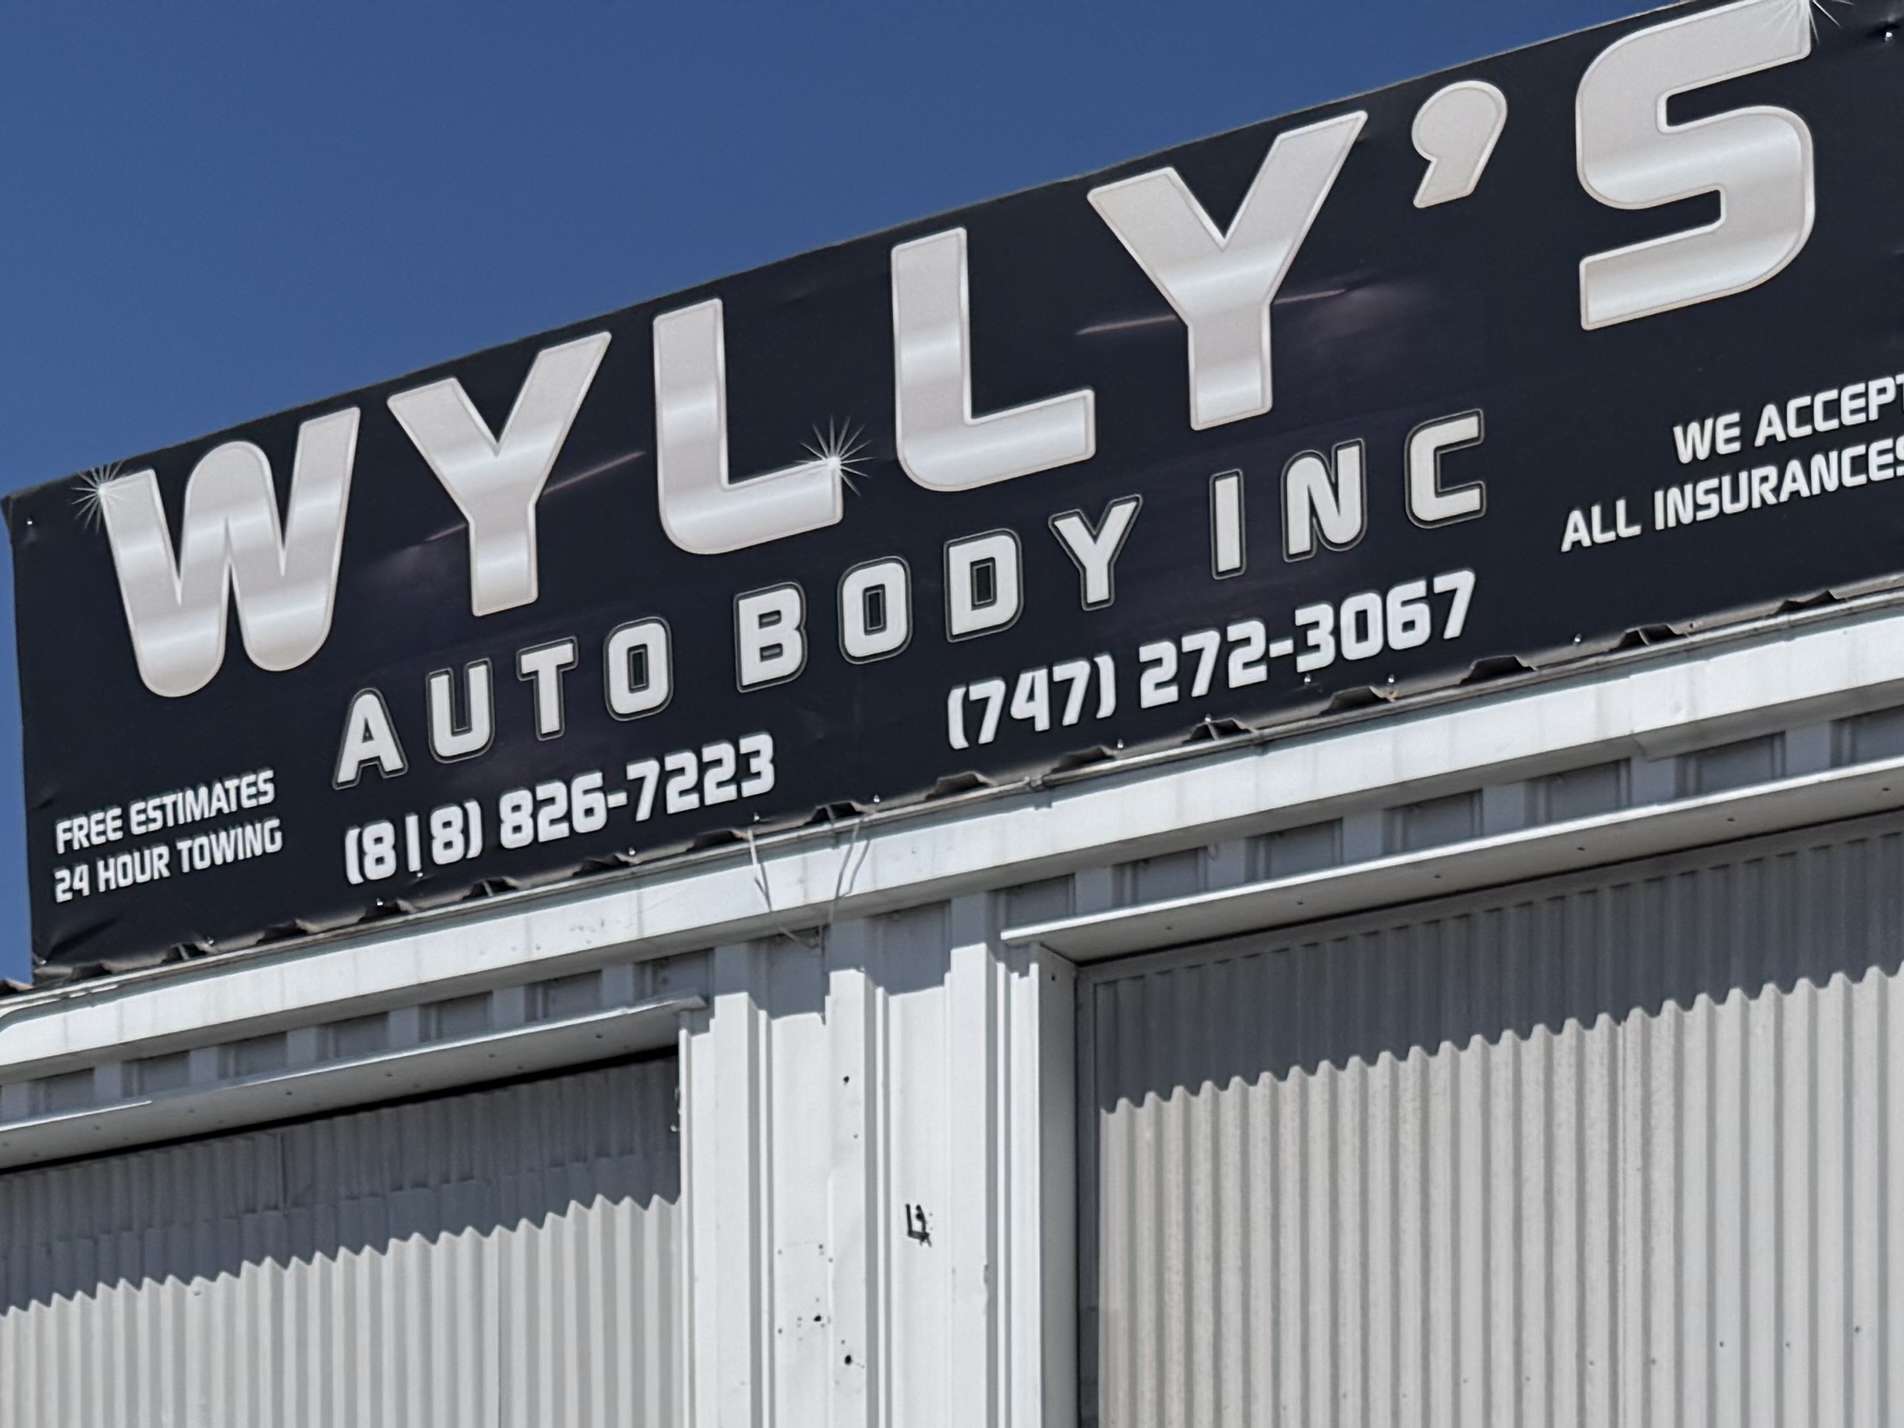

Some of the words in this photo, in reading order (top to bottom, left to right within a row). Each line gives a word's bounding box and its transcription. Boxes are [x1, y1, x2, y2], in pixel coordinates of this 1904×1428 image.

[99, 0, 1815, 699] WYLLY'S
[1673, 411, 1741, 464] WE
[1561, 498, 1642, 553] ALL
[334, 619, 672, 787] AUTO
[736, 499, 1140, 690] BODY
[1212, 412, 1483, 576] INC
[947, 654, 1116, 750] (747)
[1138, 569, 1476, 709] 272-3067
[53, 864, 90, 903] 24
[97, 845, 171, 893] HOUR
[176, 818, 283, 873] TOWING
[55, 807, 124, 854] FREE
[130, 769, 275, 836] ESTIMATES
[344, 800, 483, 885] (818)
[499, 732, 775, 849] 826-7223
